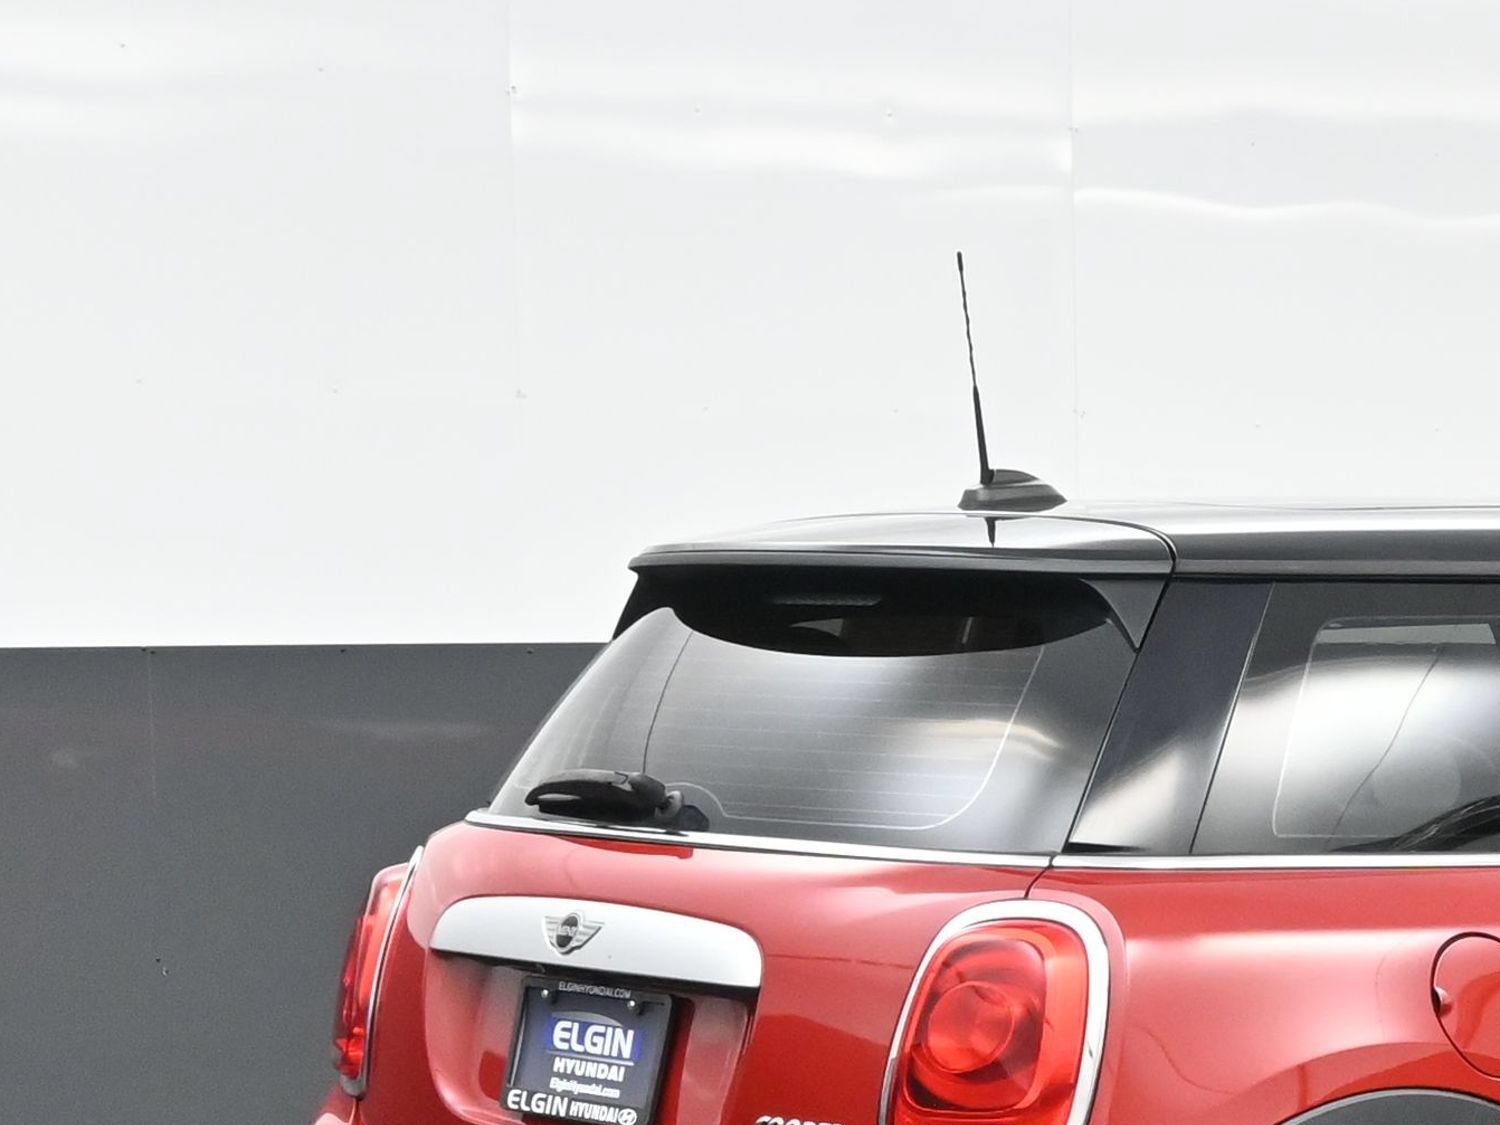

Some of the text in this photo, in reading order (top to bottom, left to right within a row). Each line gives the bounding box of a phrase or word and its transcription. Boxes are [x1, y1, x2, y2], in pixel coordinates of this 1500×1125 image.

[552, 1020, 635, 1059] ELGIN
[553, 1056, 626, 1082] HYUNDAI
[507, 1089, 619, 1124] ELGIN HYUNDAI
